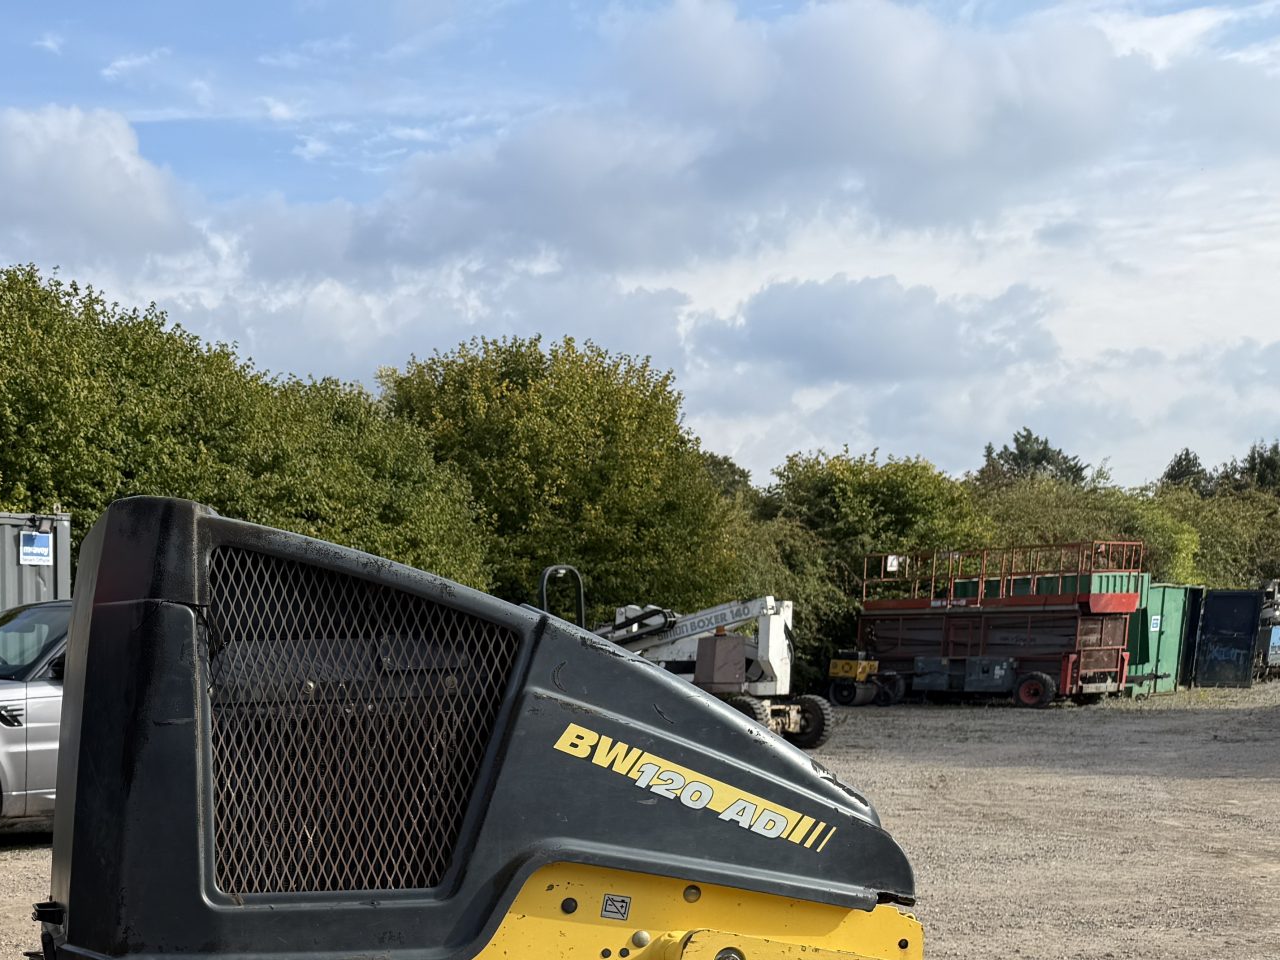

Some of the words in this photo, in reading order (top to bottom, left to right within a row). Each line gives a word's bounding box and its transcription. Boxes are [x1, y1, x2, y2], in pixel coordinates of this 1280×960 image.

[690, 612, 728, 632] BOXER
[730, 606, 750, 620] 140
[718, 798, 789, 839] AD
